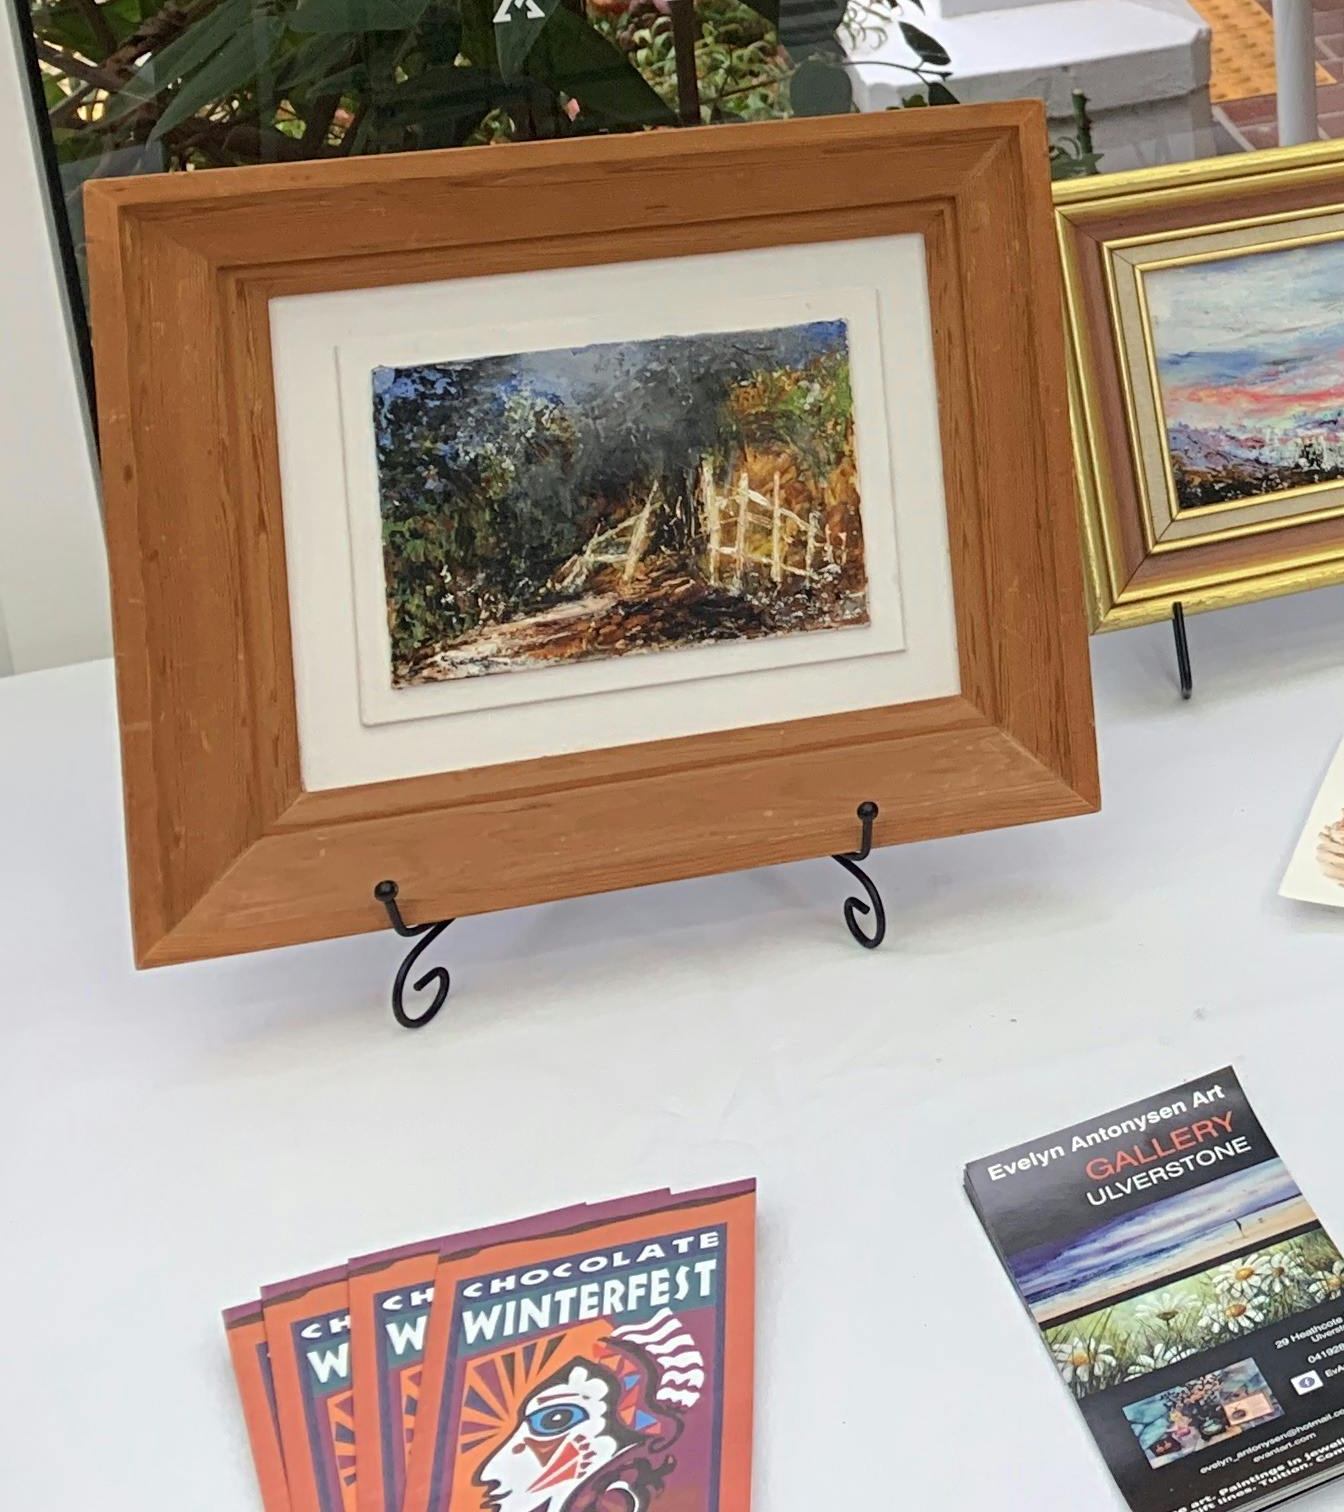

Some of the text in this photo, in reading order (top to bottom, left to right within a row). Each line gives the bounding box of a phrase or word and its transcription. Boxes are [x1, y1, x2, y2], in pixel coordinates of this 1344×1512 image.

[988, 1083, 1226, 1181] Evelyn Antonysen Art
[1084, 1110, 1236, 1182] GALLERY
[1086, 1136, 1253, 1207] ULVERSTONE
[462, 1230, 721, 1300] CHOCOLATE
[382, 1288, 435, 1311] CH
[461, 1258, 718, 1346] WINTERFEST
[301, 1315, 351, 1339] CH
[385, 1315, 428, 1355] W
[1290, 1316, 1343, 1343] Heathcote
[306, 1342, 349, 1384] W
[1190, 1493, 1217, 1511] art.
[1218, 1462, 1285, 1496] Paintings
[1218, 1484, 1257, 1506] lines.
[1258, 1460, 1314, 1487] Tuition.
